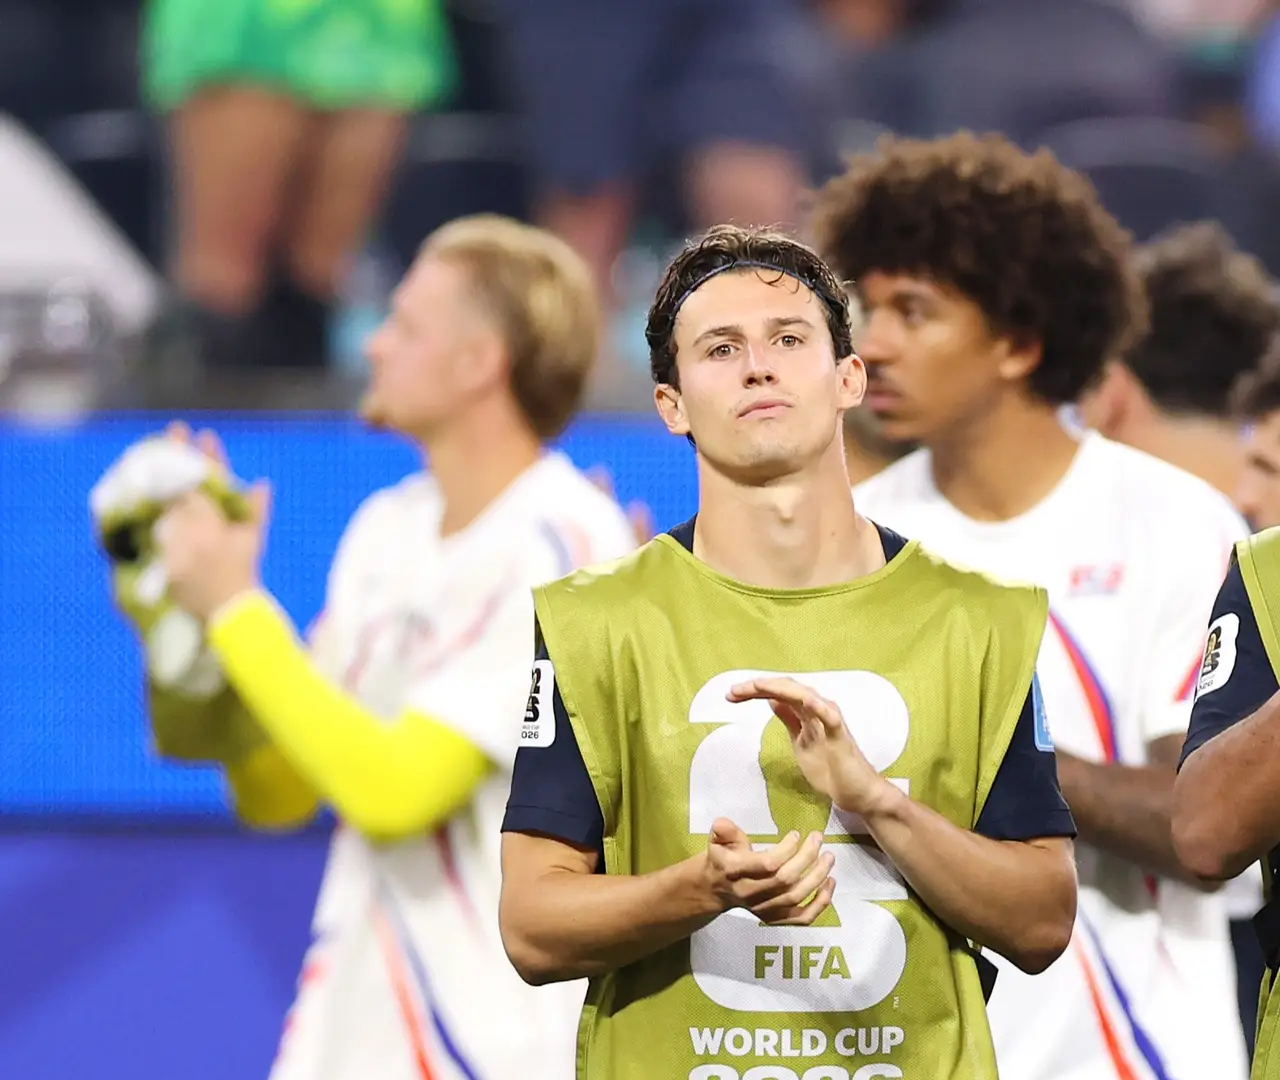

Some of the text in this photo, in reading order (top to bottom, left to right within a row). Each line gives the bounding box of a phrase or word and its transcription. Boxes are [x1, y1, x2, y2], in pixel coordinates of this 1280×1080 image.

[754, 945, 852, 980] FIFA
[688, 1025, 906, 1057] WORLD CUP
